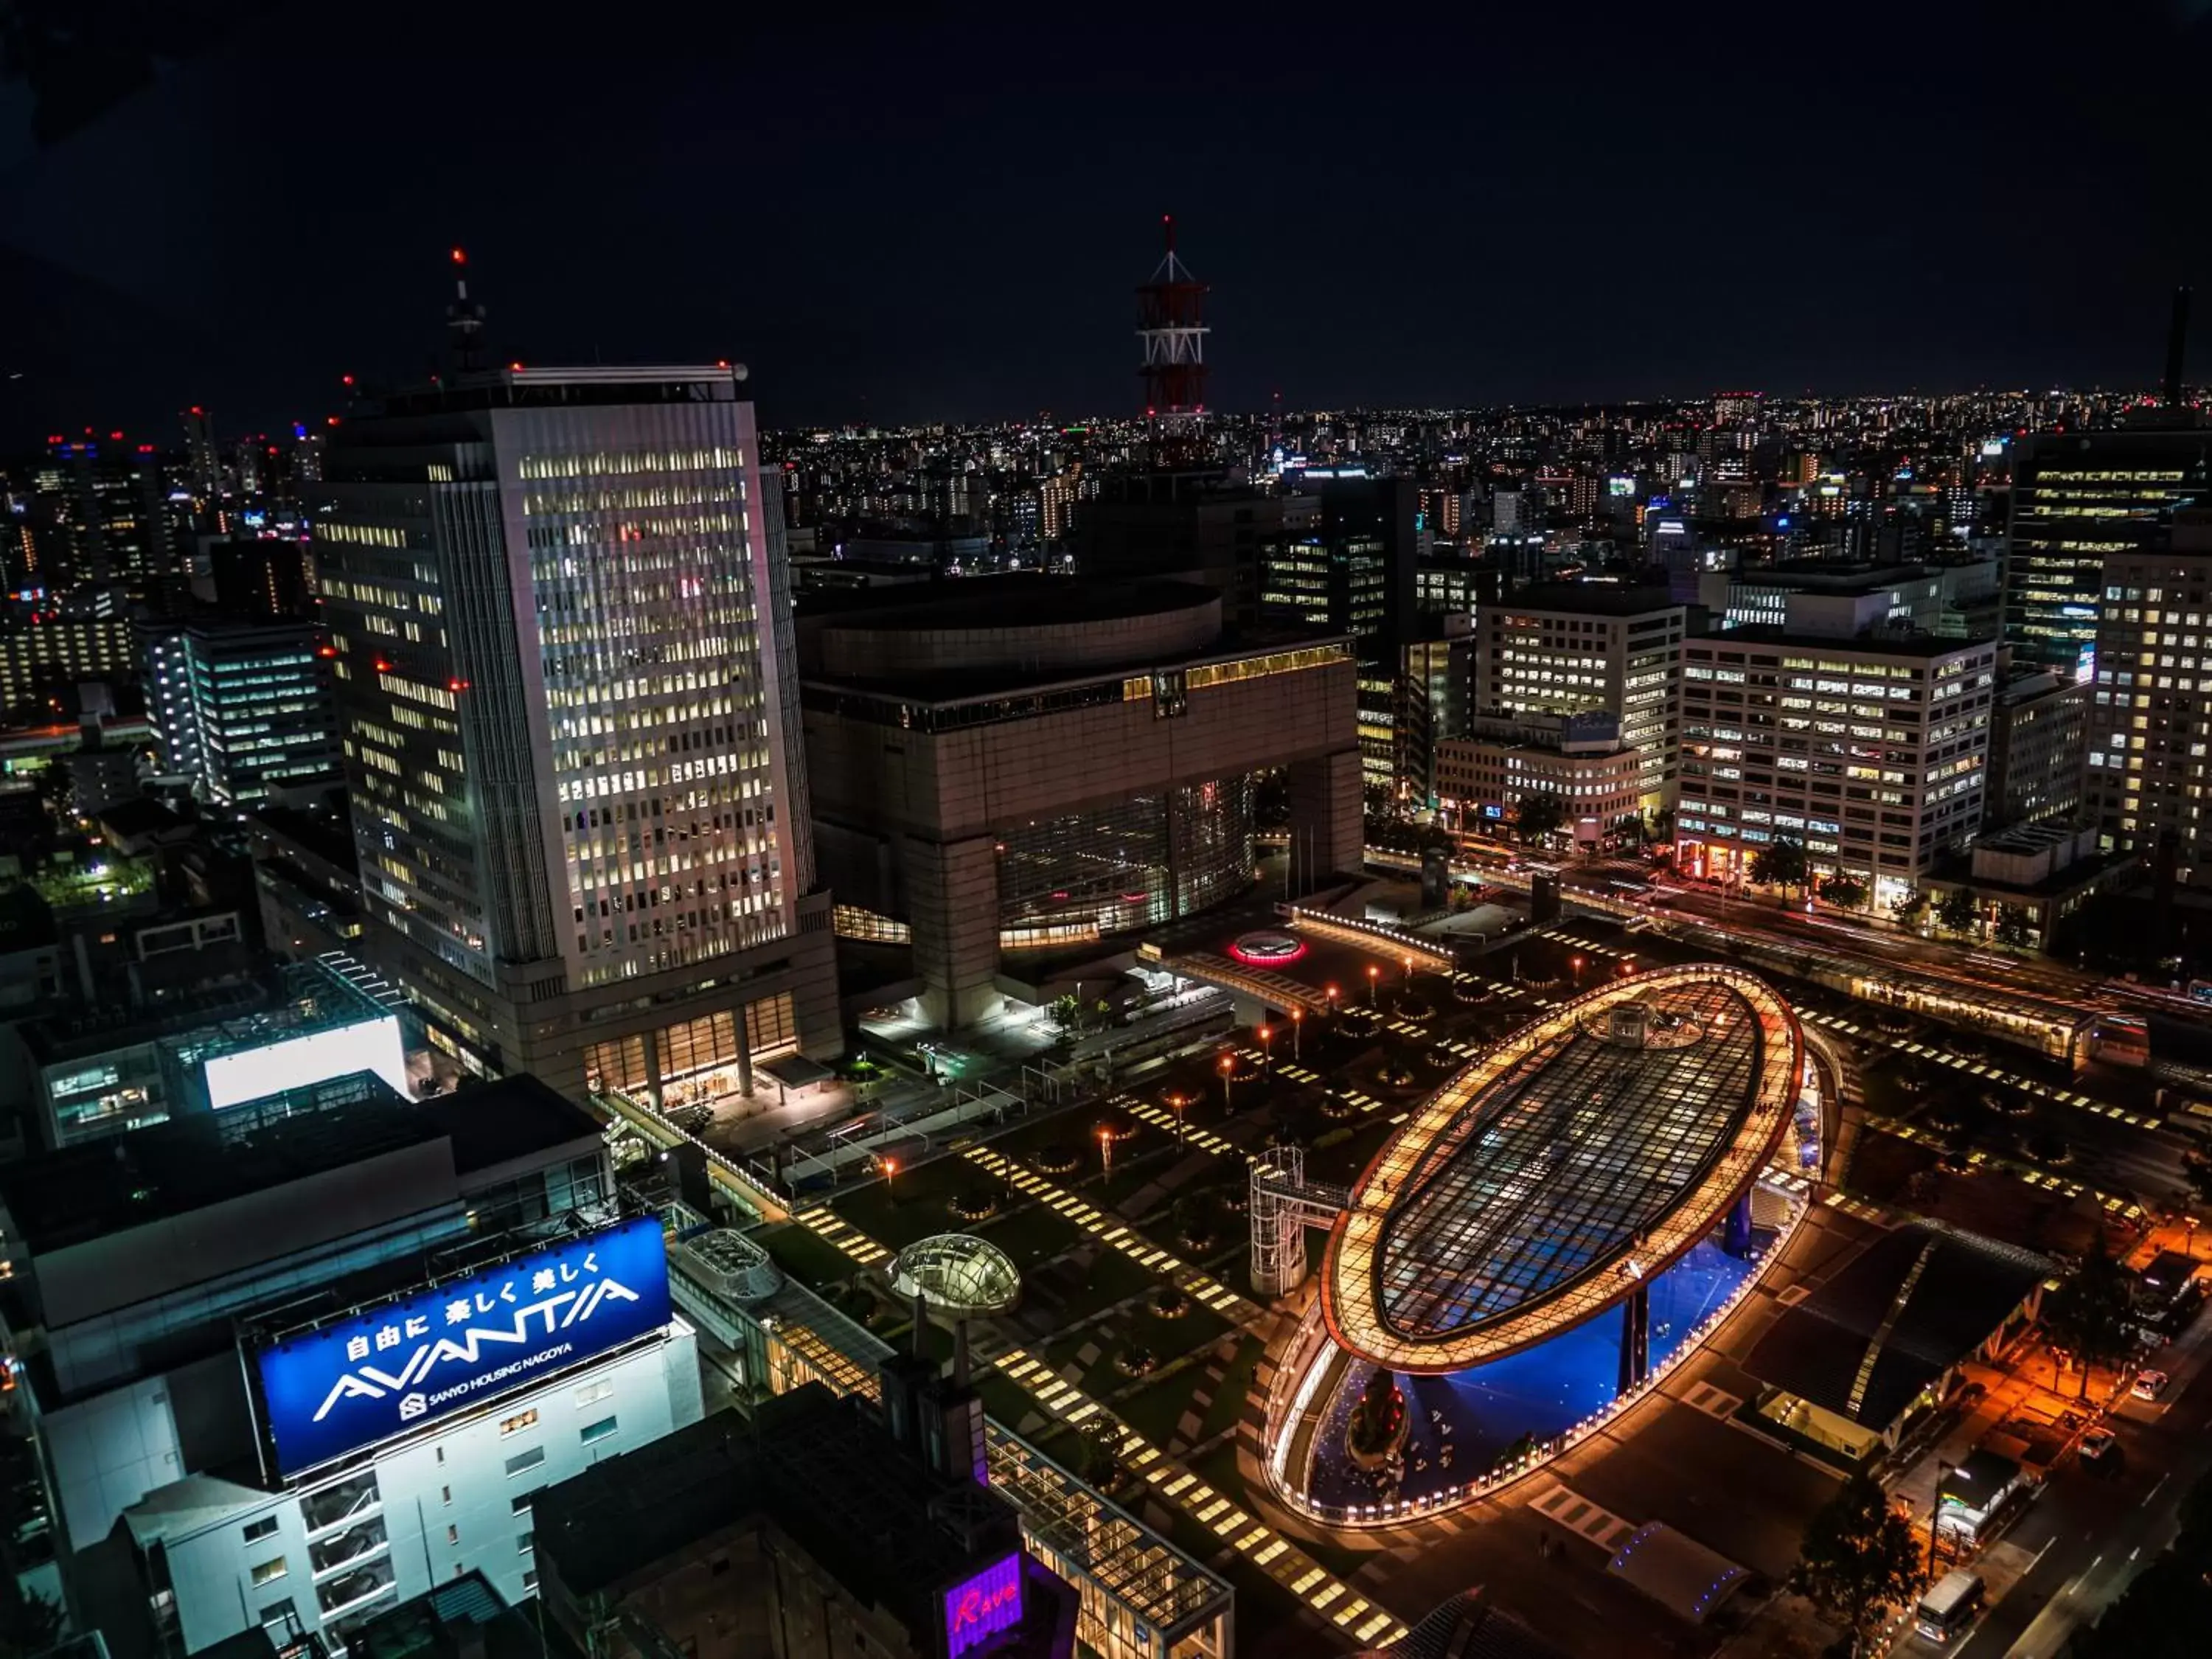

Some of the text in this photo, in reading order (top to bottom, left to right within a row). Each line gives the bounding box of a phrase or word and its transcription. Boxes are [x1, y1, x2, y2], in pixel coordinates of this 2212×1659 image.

[313, 1278, 639, 1422] AVANTIA
[347, 1252, 599, 1363] 自由に 楽しく 美しく
[429, 1342, 573, 1406] SANYO HOUSING NAGOYA
